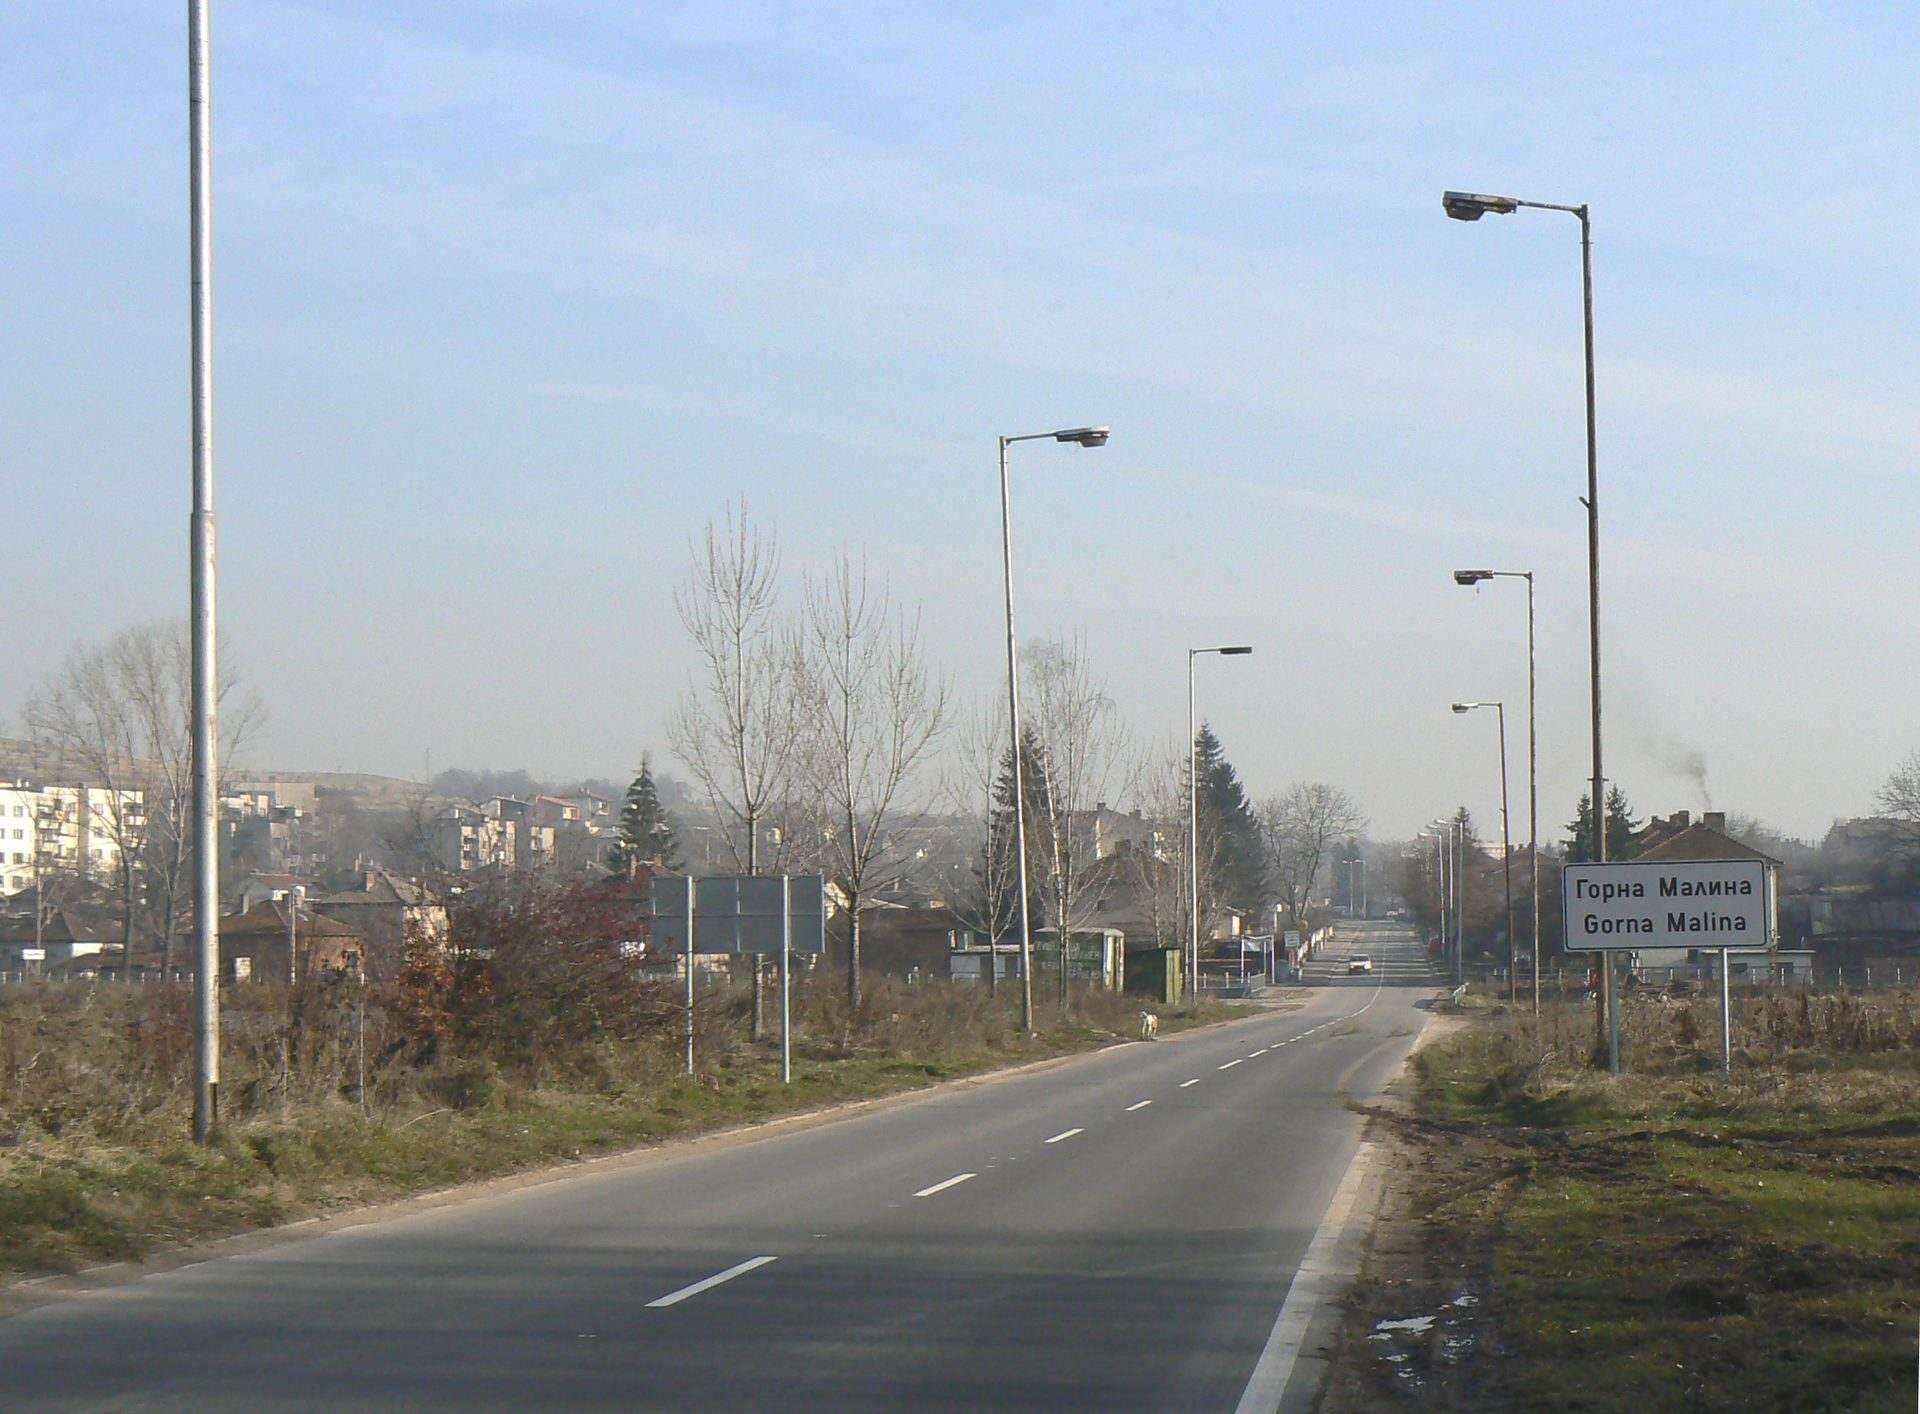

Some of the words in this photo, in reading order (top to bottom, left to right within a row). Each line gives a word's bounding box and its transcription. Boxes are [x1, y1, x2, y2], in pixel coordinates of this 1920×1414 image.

[1576, 879, 1645, 904] Горна
[1658, 877, 1752, 898] Малина
[1583, 913, 1654, 935] Gorna
[1667, 911, 1746, 933] Malina
